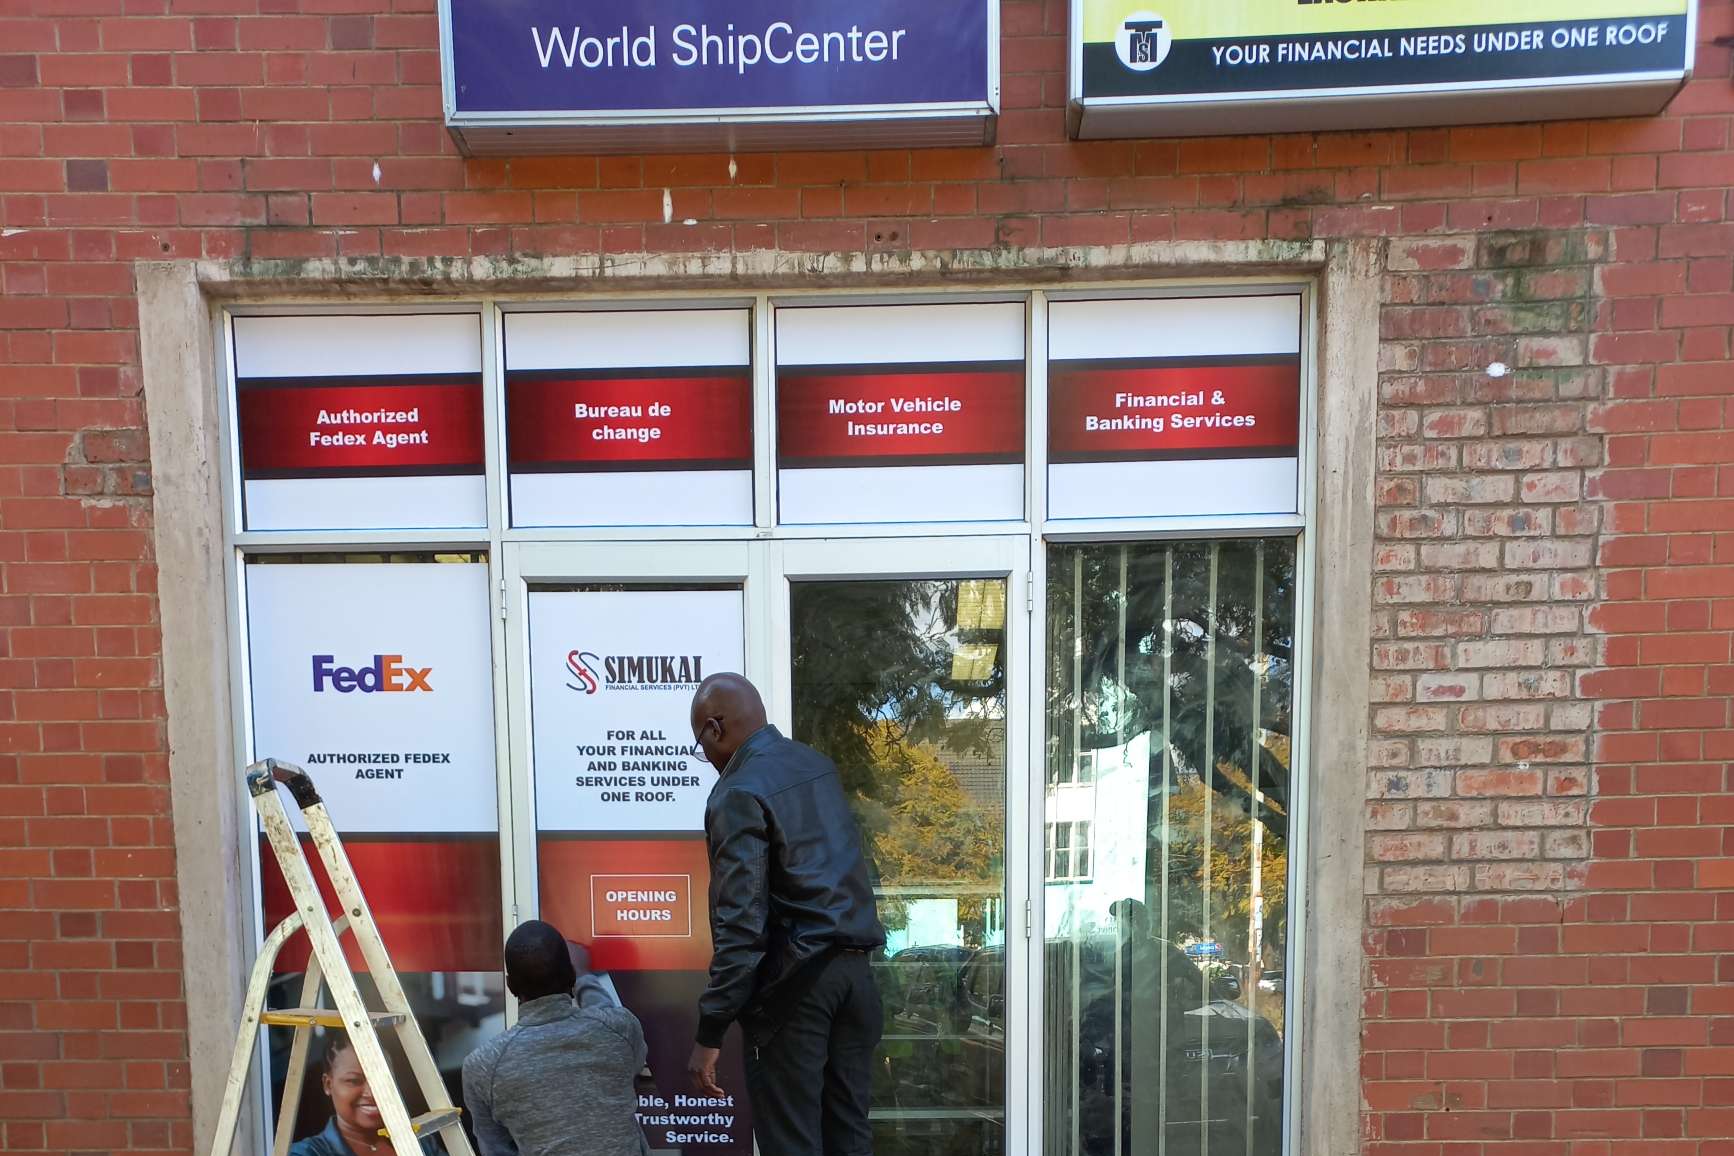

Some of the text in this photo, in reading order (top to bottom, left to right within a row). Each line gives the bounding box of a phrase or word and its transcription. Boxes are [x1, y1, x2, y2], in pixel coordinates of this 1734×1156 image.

[531, 22, 906, 74] World ShipCenter
[1212, 22, 1669, 66] YOUR FINANCIAL NEEDS UNDER ONE ROOF
[828, 397, 962, 415] Motor Vehicle
[1115, 390, 1226, 408] Financial &
[316, 408, 420, 426] Authorized
[575, 402, 672, 419] Bureau de
[847, 421, 944, 436] Insurance
[1085, 412, 1256, 433] Banking Services
[309, 430, 429, 449] Fedex Agent
[592, 427, 661, 443] change
[312, 655, 434, 693] FedEx
[604, 656, 702, 684] SIMUKAI
[607, 730, 667, 741] FOR ALL
[307, 753, 451, 764] AUTHORIZED FEDEX
[576, 746, 617, 756] YOUR
[587, 761, 688, 771] AND BANKING
[355, 769, 404, 779] AGENT
[576, 776, 700, 787] SERVICES UNDER
[600, 791, 676, 802] ONE ROOF.
[606, 891, 677, 902] OPENING
[616, 909, 672, 921] HOURS
[674, 1095, 735, 1107] Honest
[665, 1131, 735, 1143] Service.
